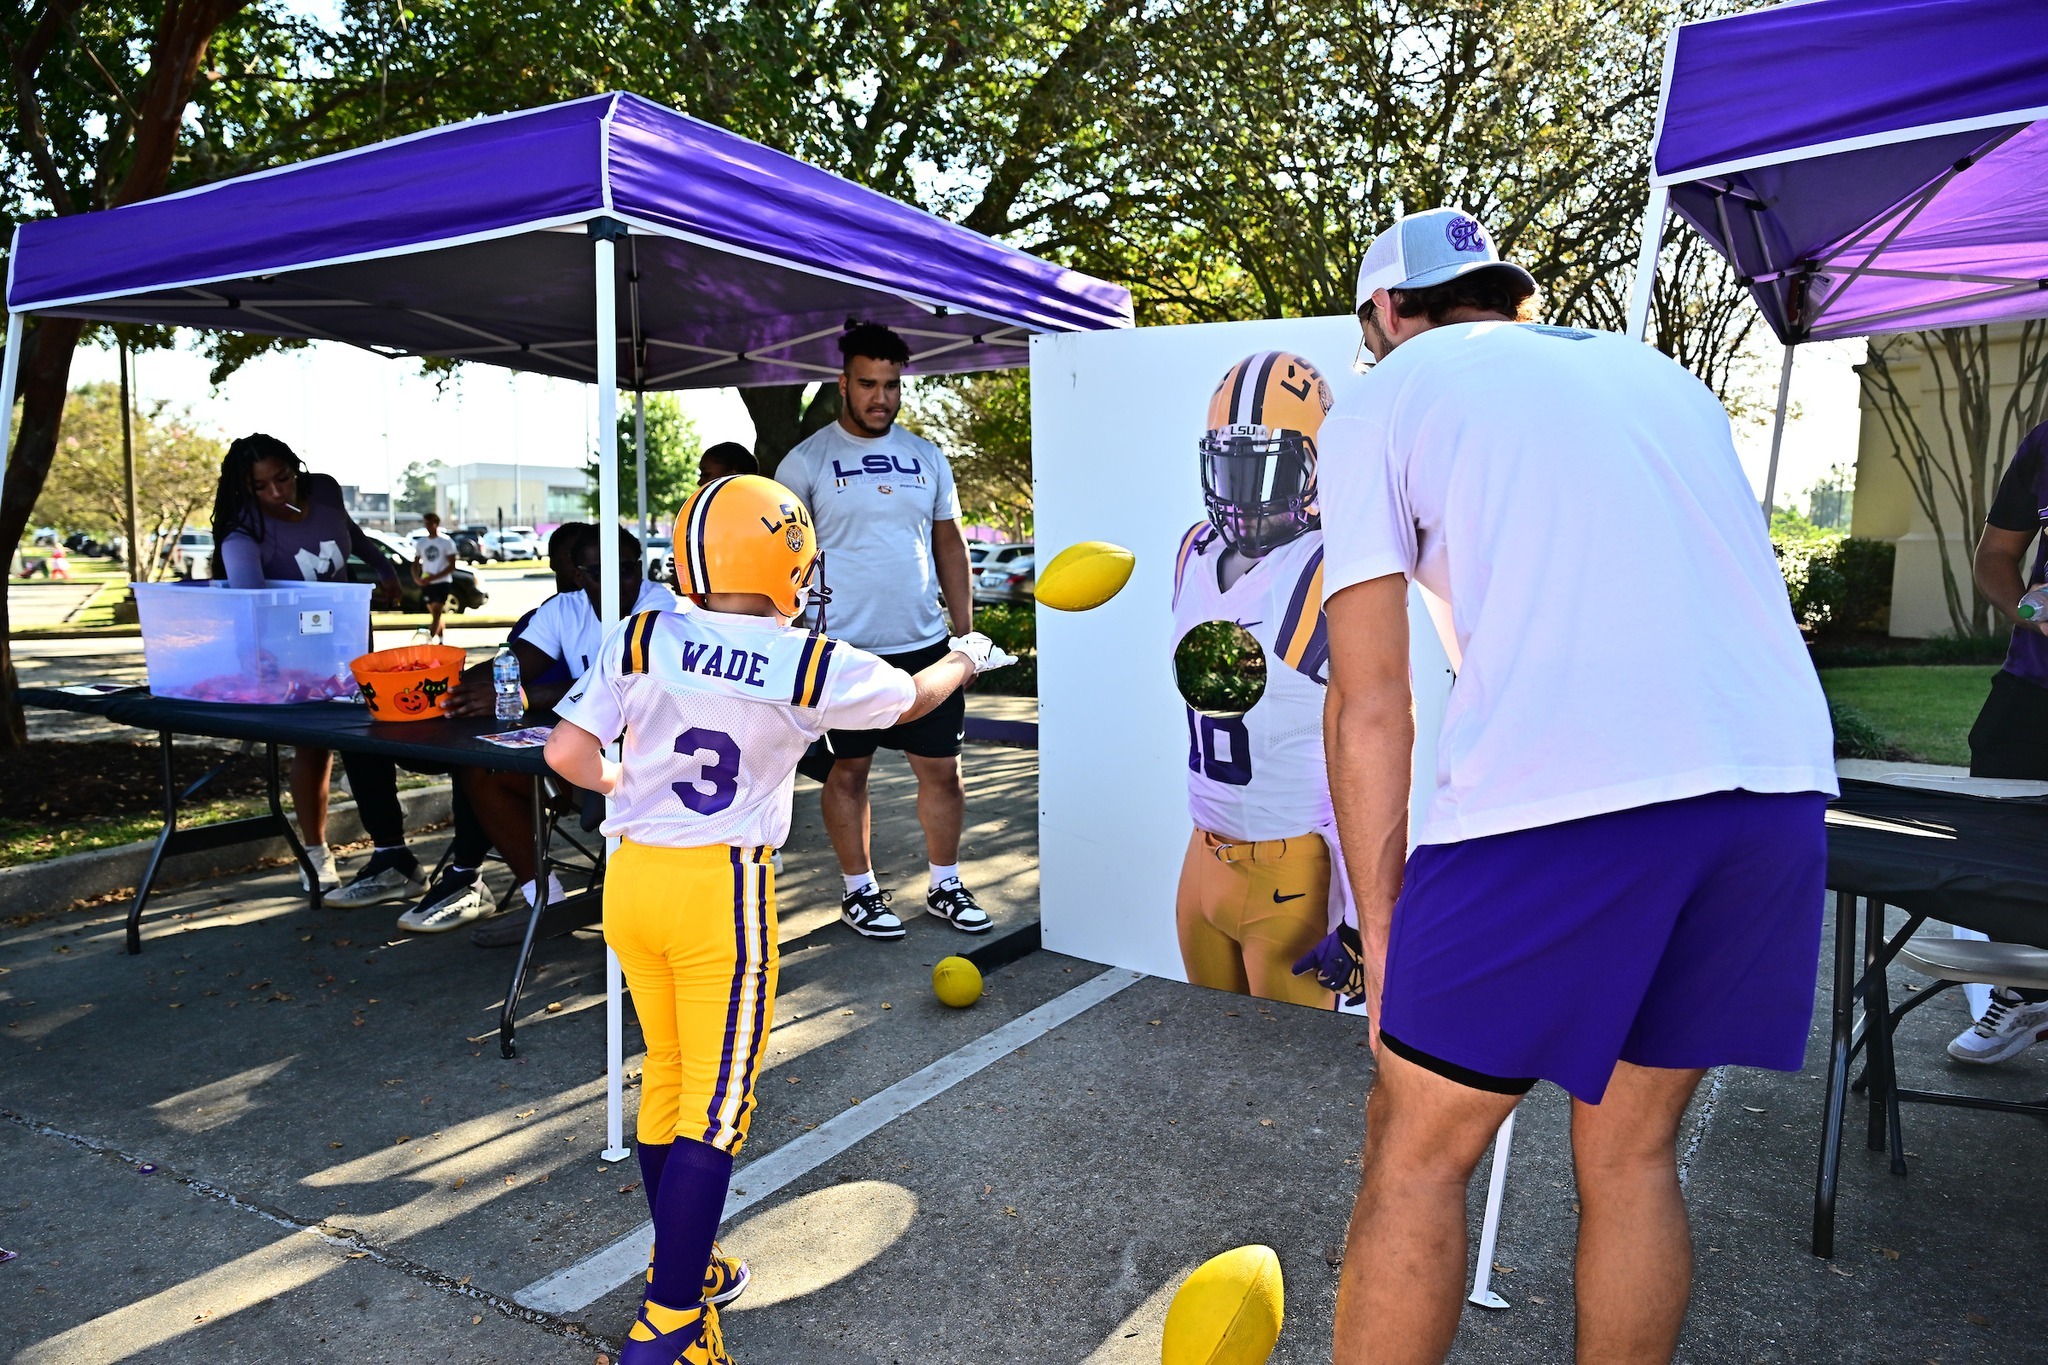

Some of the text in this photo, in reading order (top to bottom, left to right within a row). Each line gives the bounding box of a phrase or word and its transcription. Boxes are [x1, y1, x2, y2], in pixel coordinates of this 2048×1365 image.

[1230, 425, 1256, 436] LSU
[832, 454, 922, 478] LSU
[760, 503, 809, 535] LSU
[682, 640, 770, 688] WADE
[671, 726, 741, 817] 3
